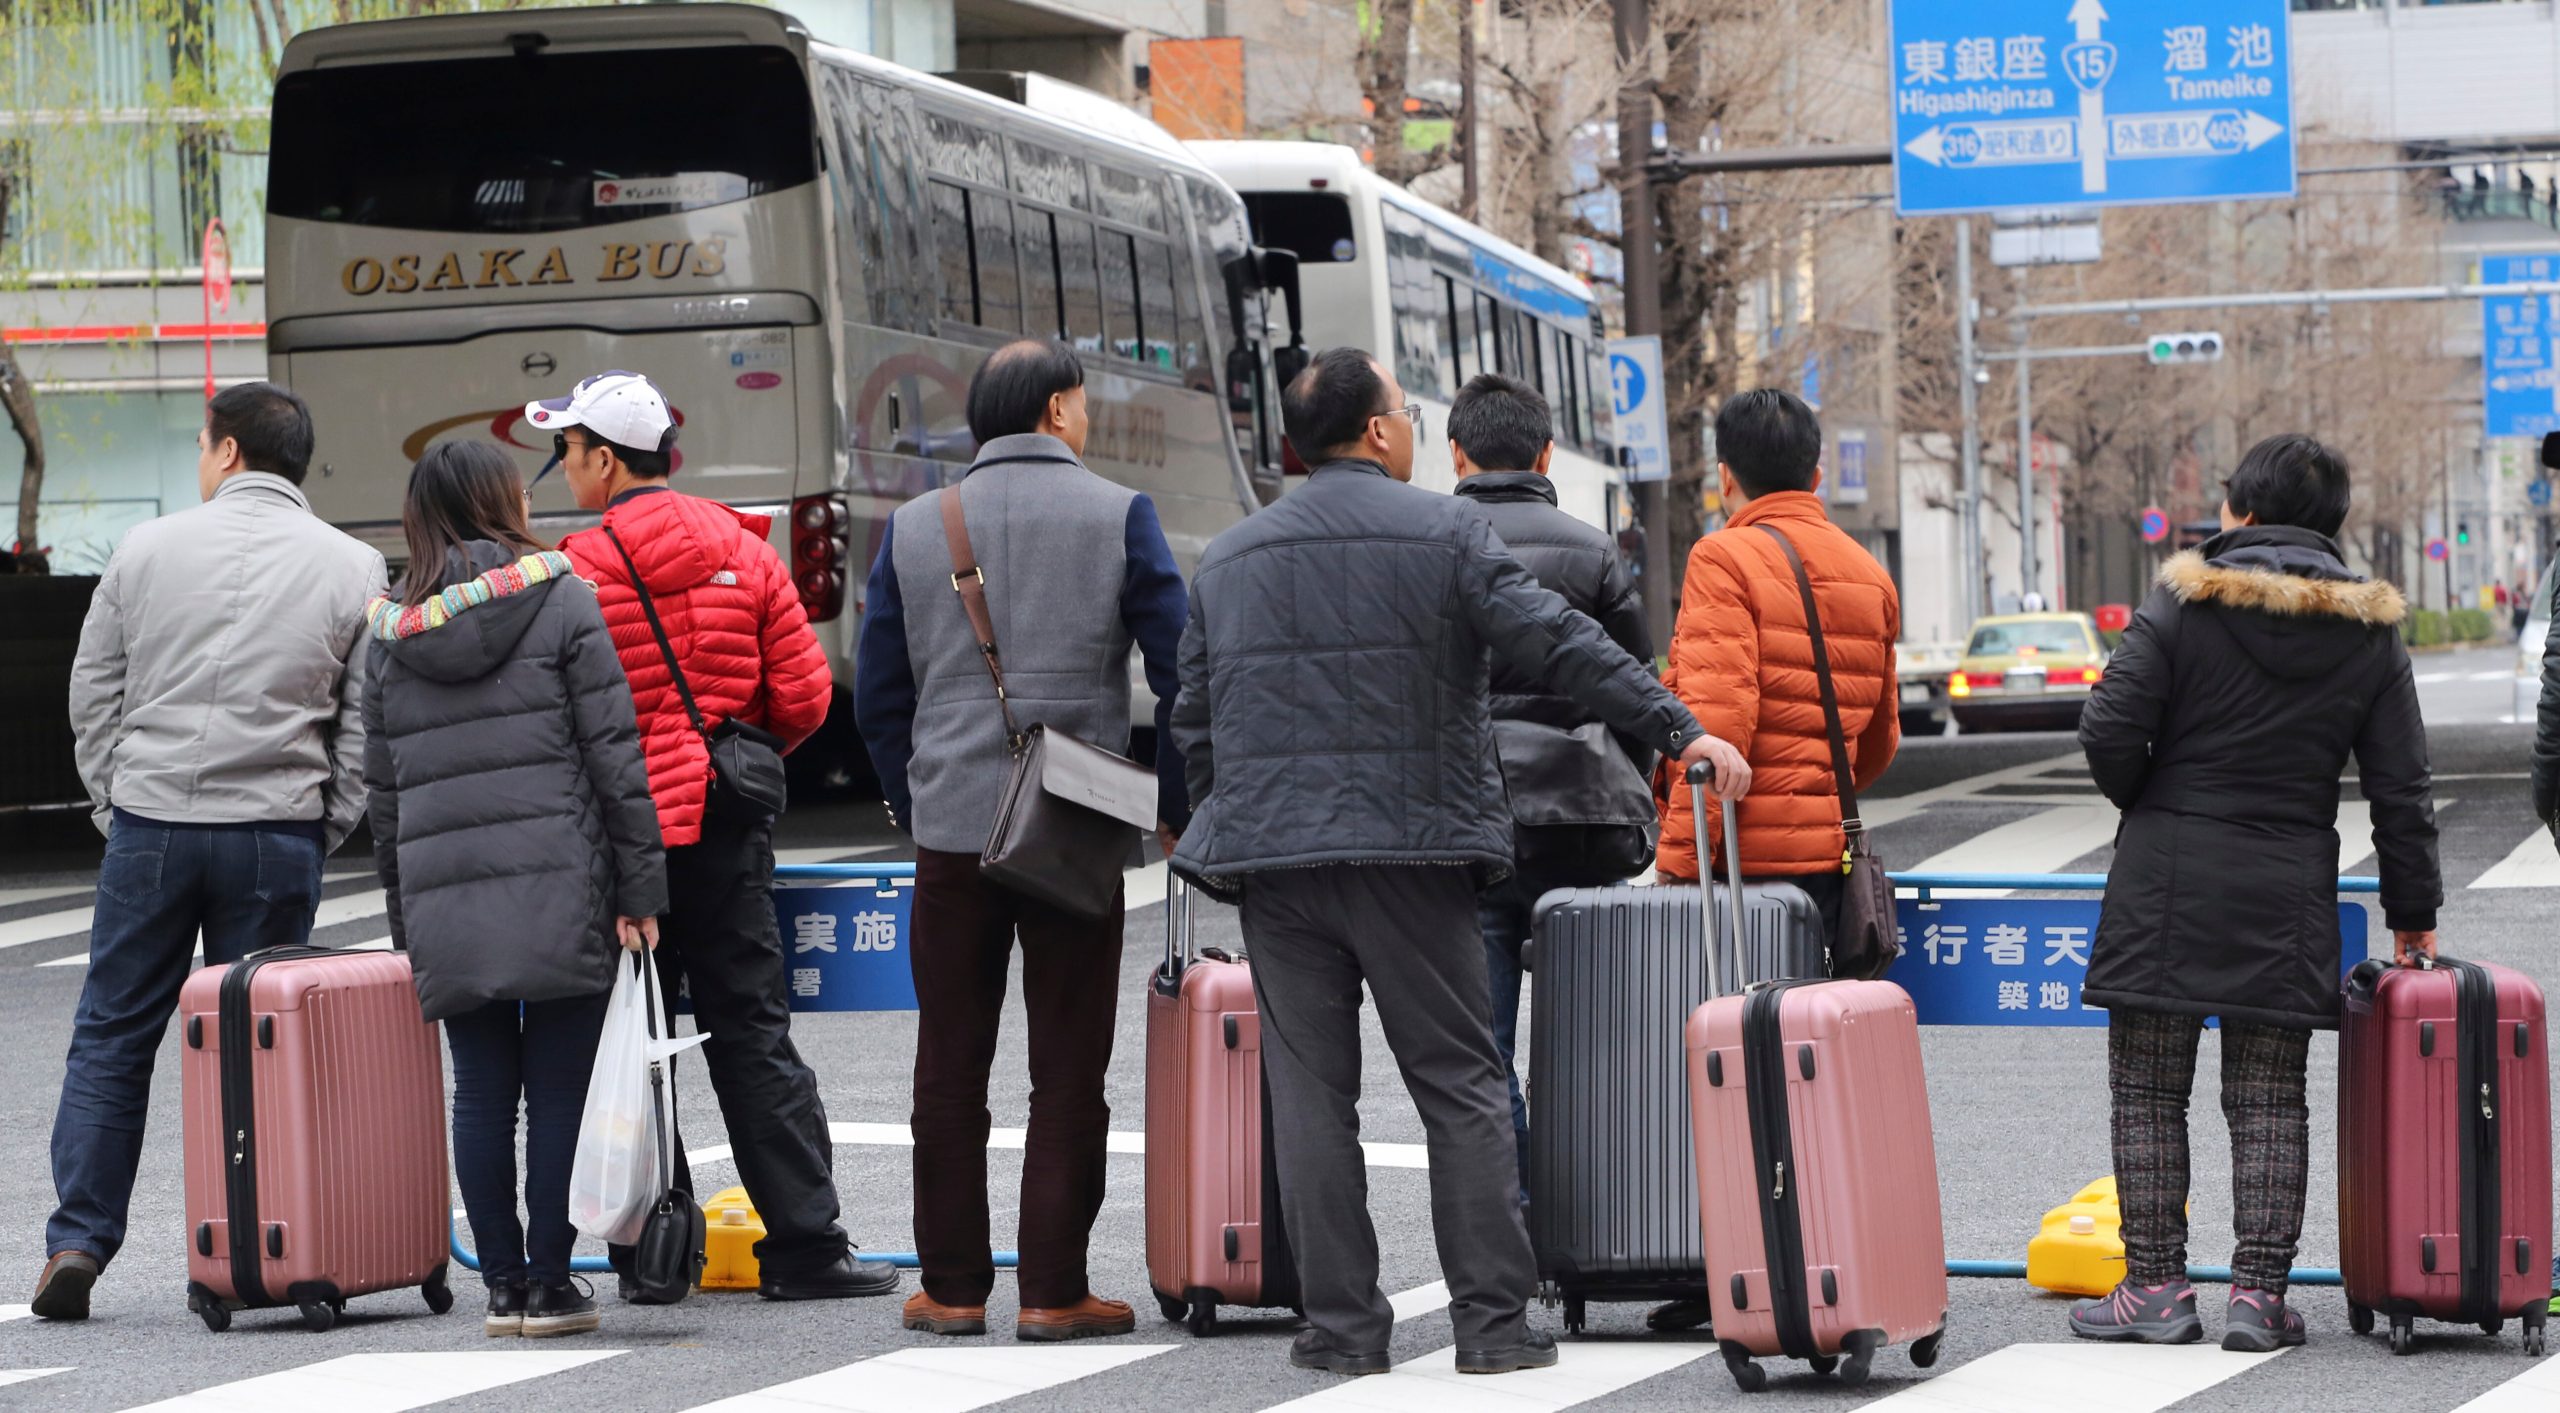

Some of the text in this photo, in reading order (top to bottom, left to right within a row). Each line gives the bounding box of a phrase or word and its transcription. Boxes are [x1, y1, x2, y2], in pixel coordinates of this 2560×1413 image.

[1902, 34, 2047, 85] 東銀座
[2162, 23, 2273, 72] 溜池
[2073, 49, 2106, 80] 15
[1899, 85, 2055, 118] Higashiginza
[2164, 73, 2273, 101] Tameike
[1946, 133, 1979, 157] 316
[2207, 120, 2247, 145] 405
[341, 239, 726, 297] OSAKA BUS
[1126, 403, 1167, 469] BUS
[794, 911, 897, 954] 実施
[792, 968, 822, 997] 署
[1998, 981, 2109, 1010] 築地
